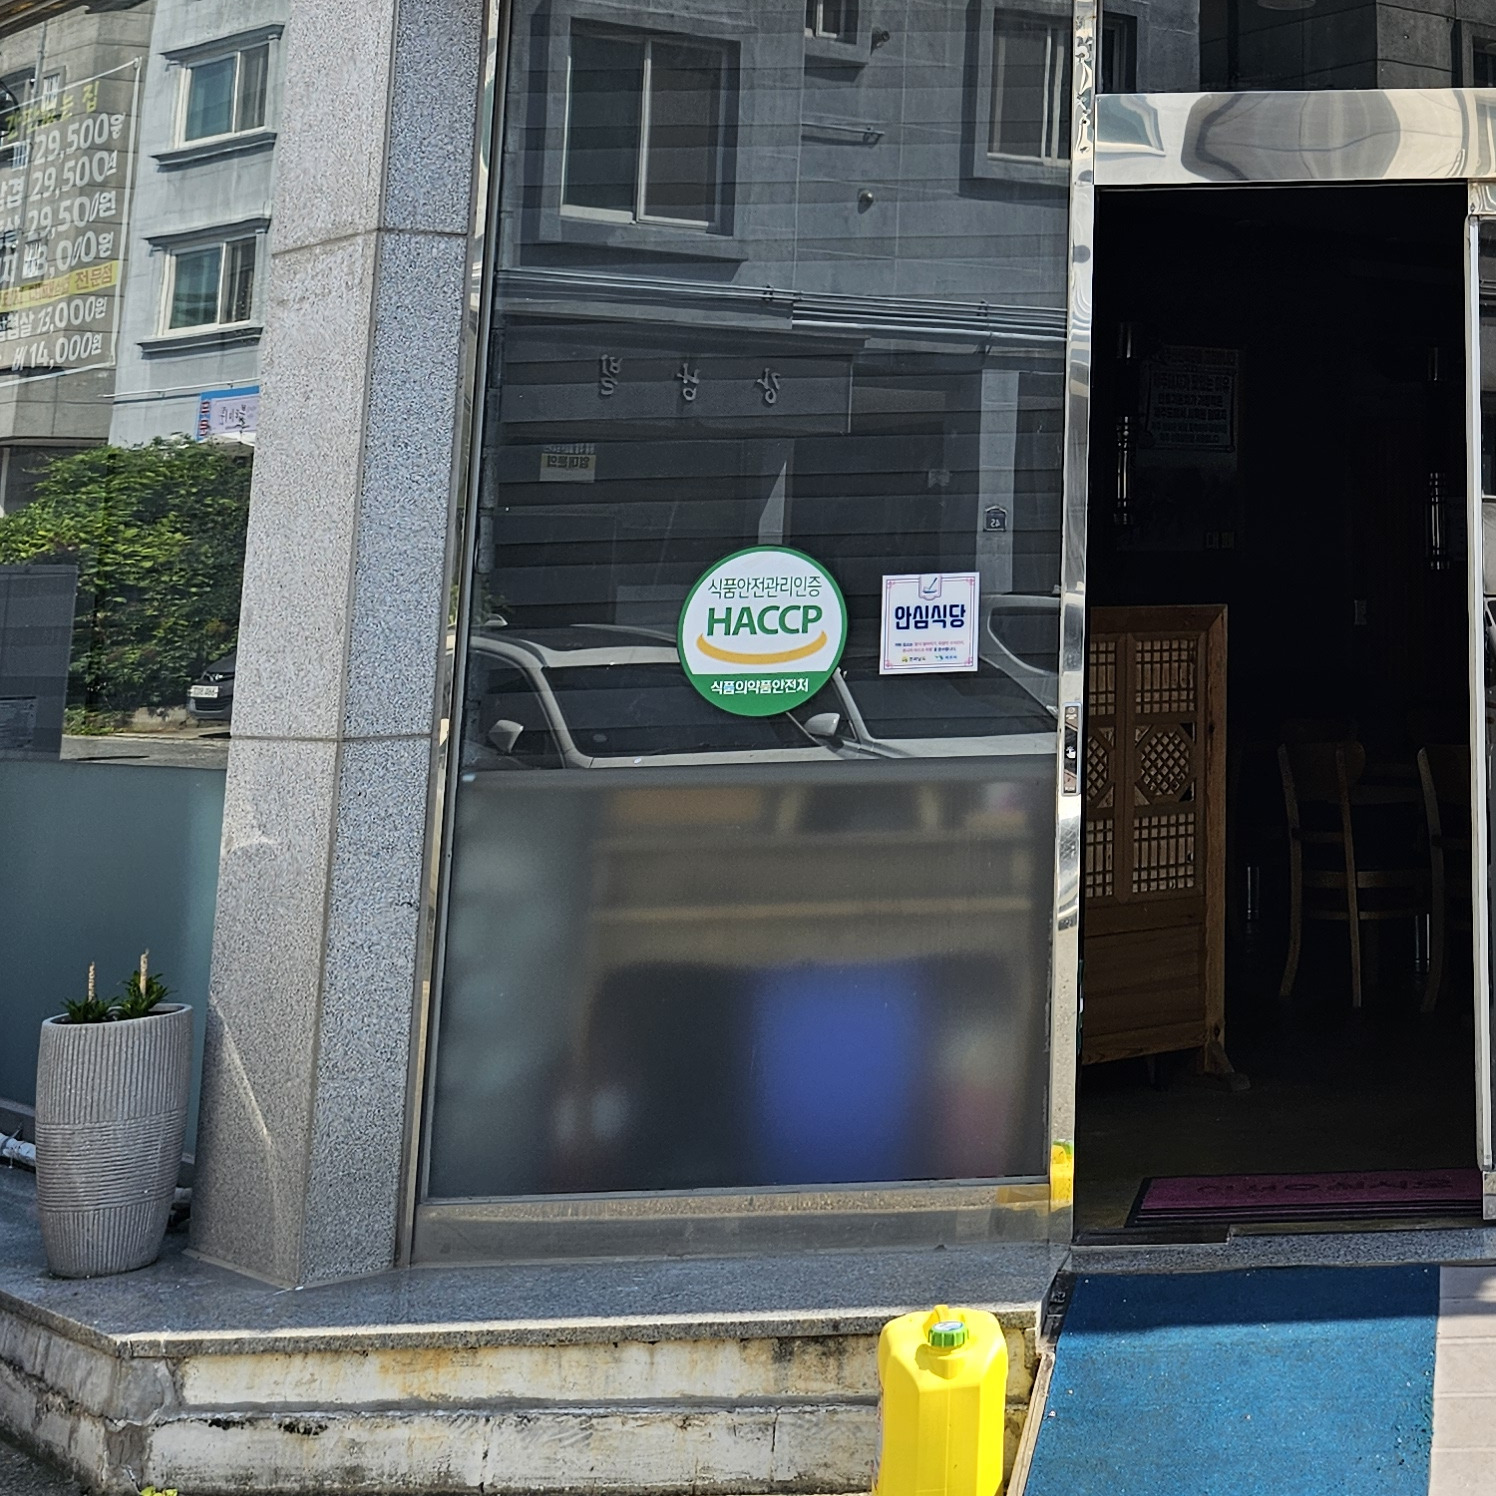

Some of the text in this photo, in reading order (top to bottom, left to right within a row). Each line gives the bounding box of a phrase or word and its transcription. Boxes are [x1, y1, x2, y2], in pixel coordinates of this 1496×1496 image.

[708, 575, 822, 600] 식품안전관리인증
[706, 604, 823, 637] HACCP
[895, 604, 966, 630] 안심식당
[710, 678, 809, 695] 식품의약품안전처
